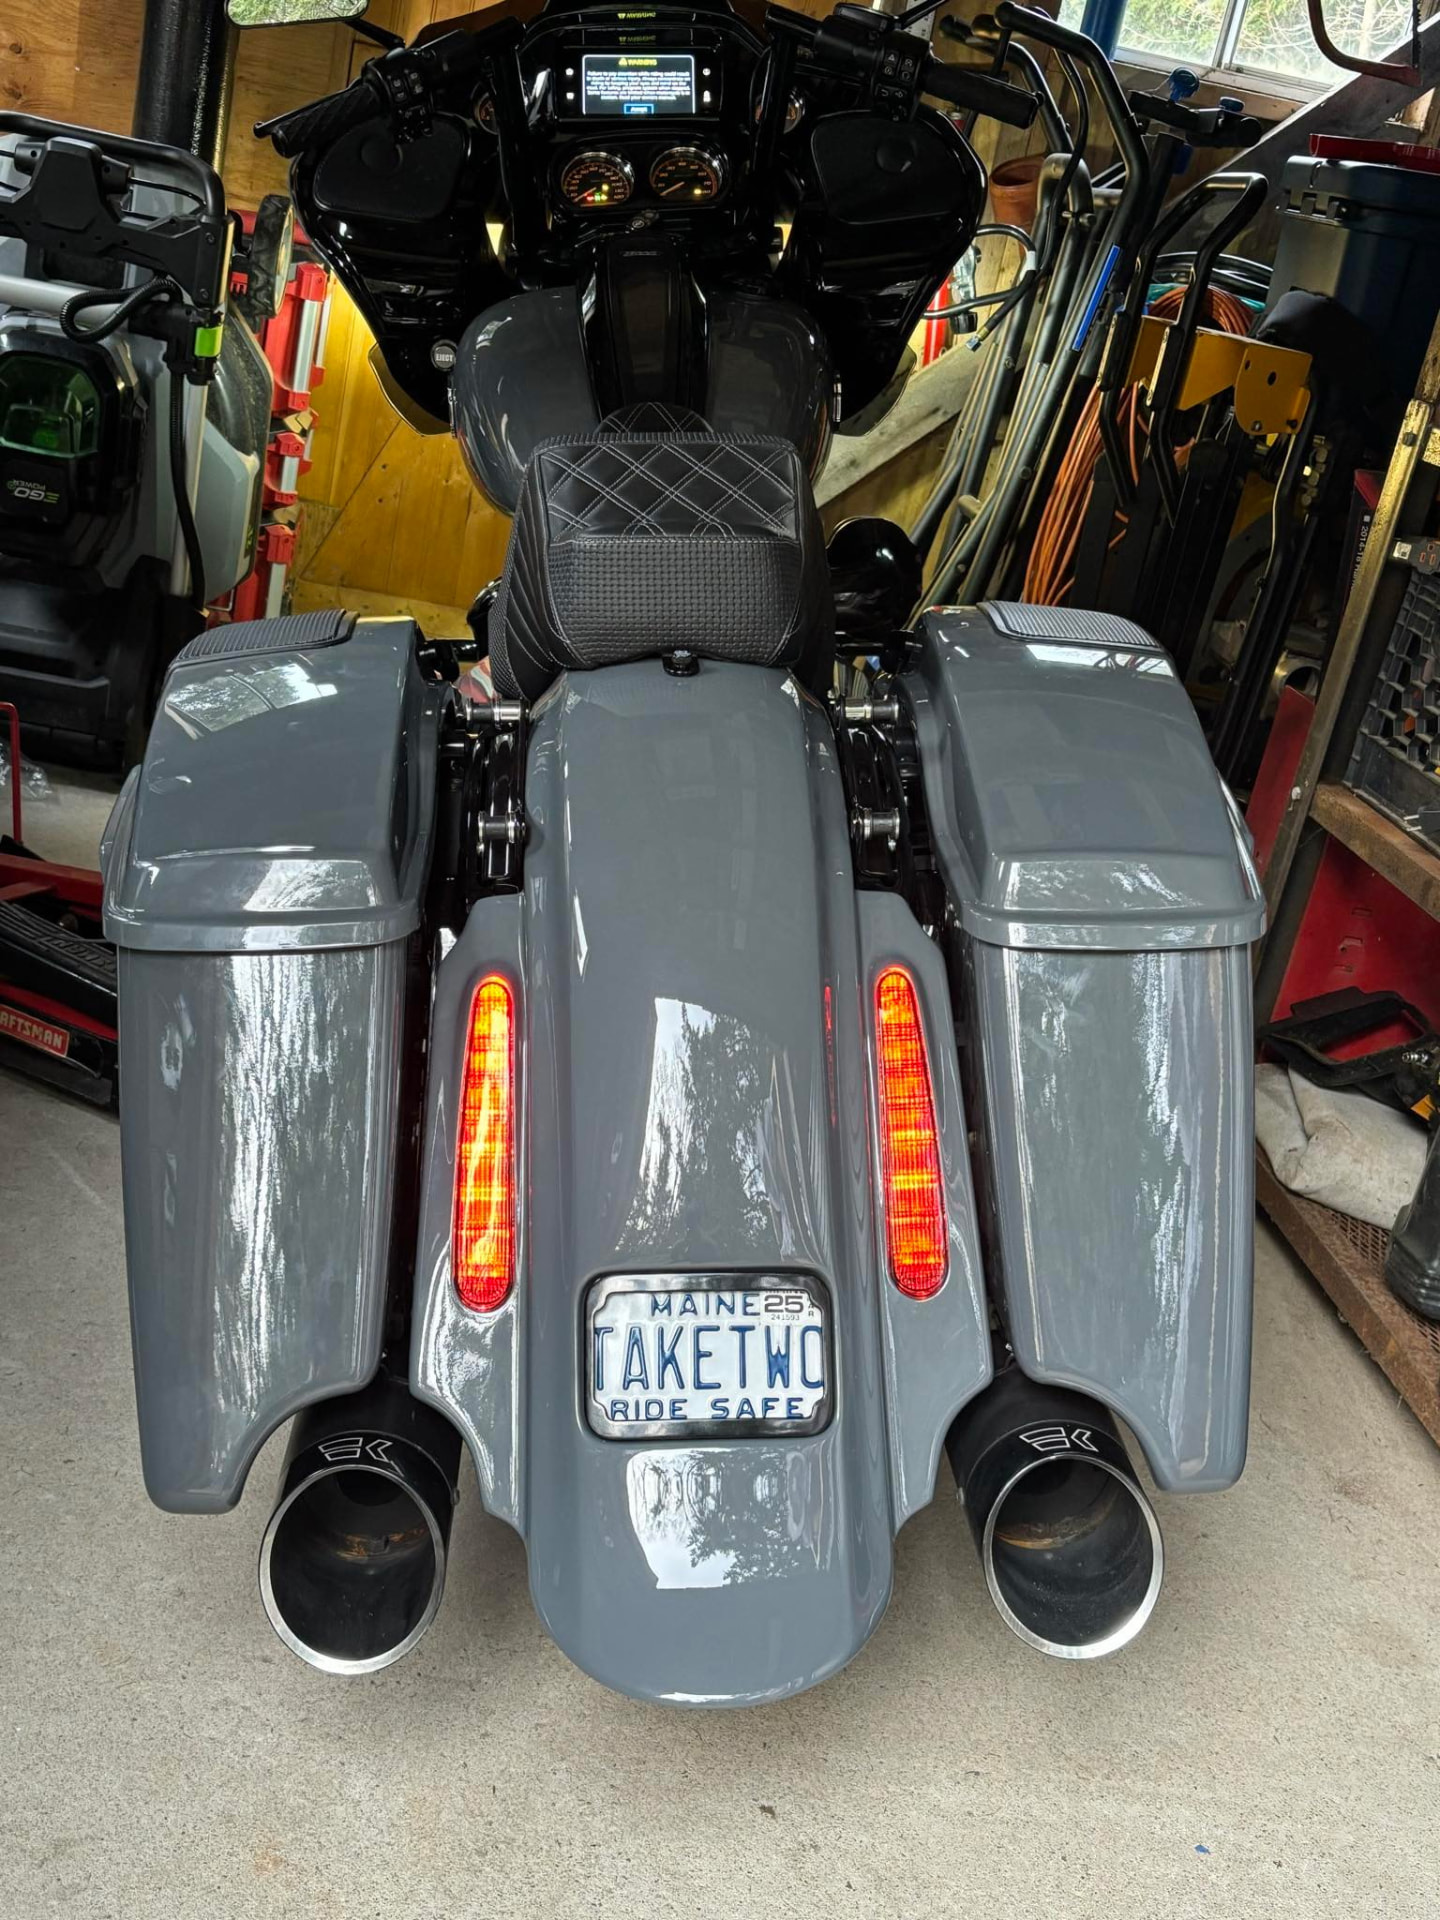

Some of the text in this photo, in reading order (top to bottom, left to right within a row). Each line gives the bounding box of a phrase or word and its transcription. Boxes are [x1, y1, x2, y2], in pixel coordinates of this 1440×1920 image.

[650, 1293, 805, 1317] MAINE 25
[594, 1325, 824, 1391] TAKETWO
[610, 1397, 804, 1420] RIDE SAFE
